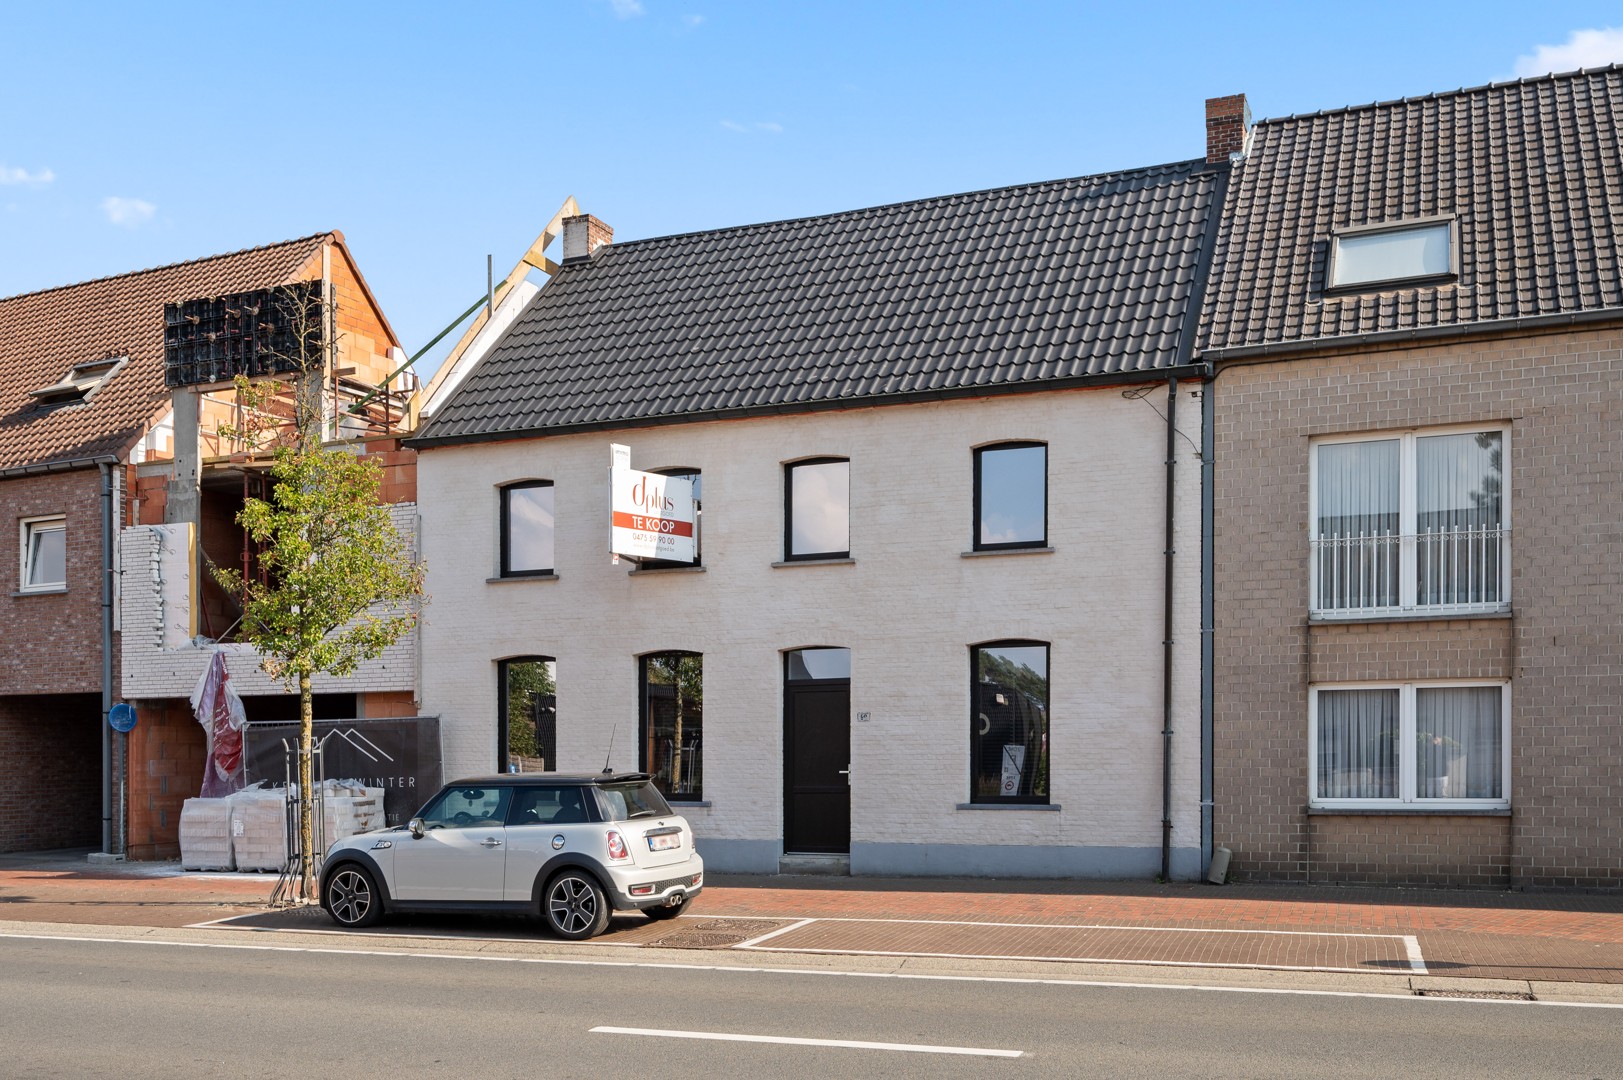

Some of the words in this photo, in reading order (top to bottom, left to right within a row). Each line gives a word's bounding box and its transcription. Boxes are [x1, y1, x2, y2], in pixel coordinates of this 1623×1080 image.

[632, 476, 675, 513] dplus
[632, 515, 643, 529] TE
[646, 518, 675, 533] KOOP
[658, 535, 666, 544] 90
[667, 536, 675, 545] 00
